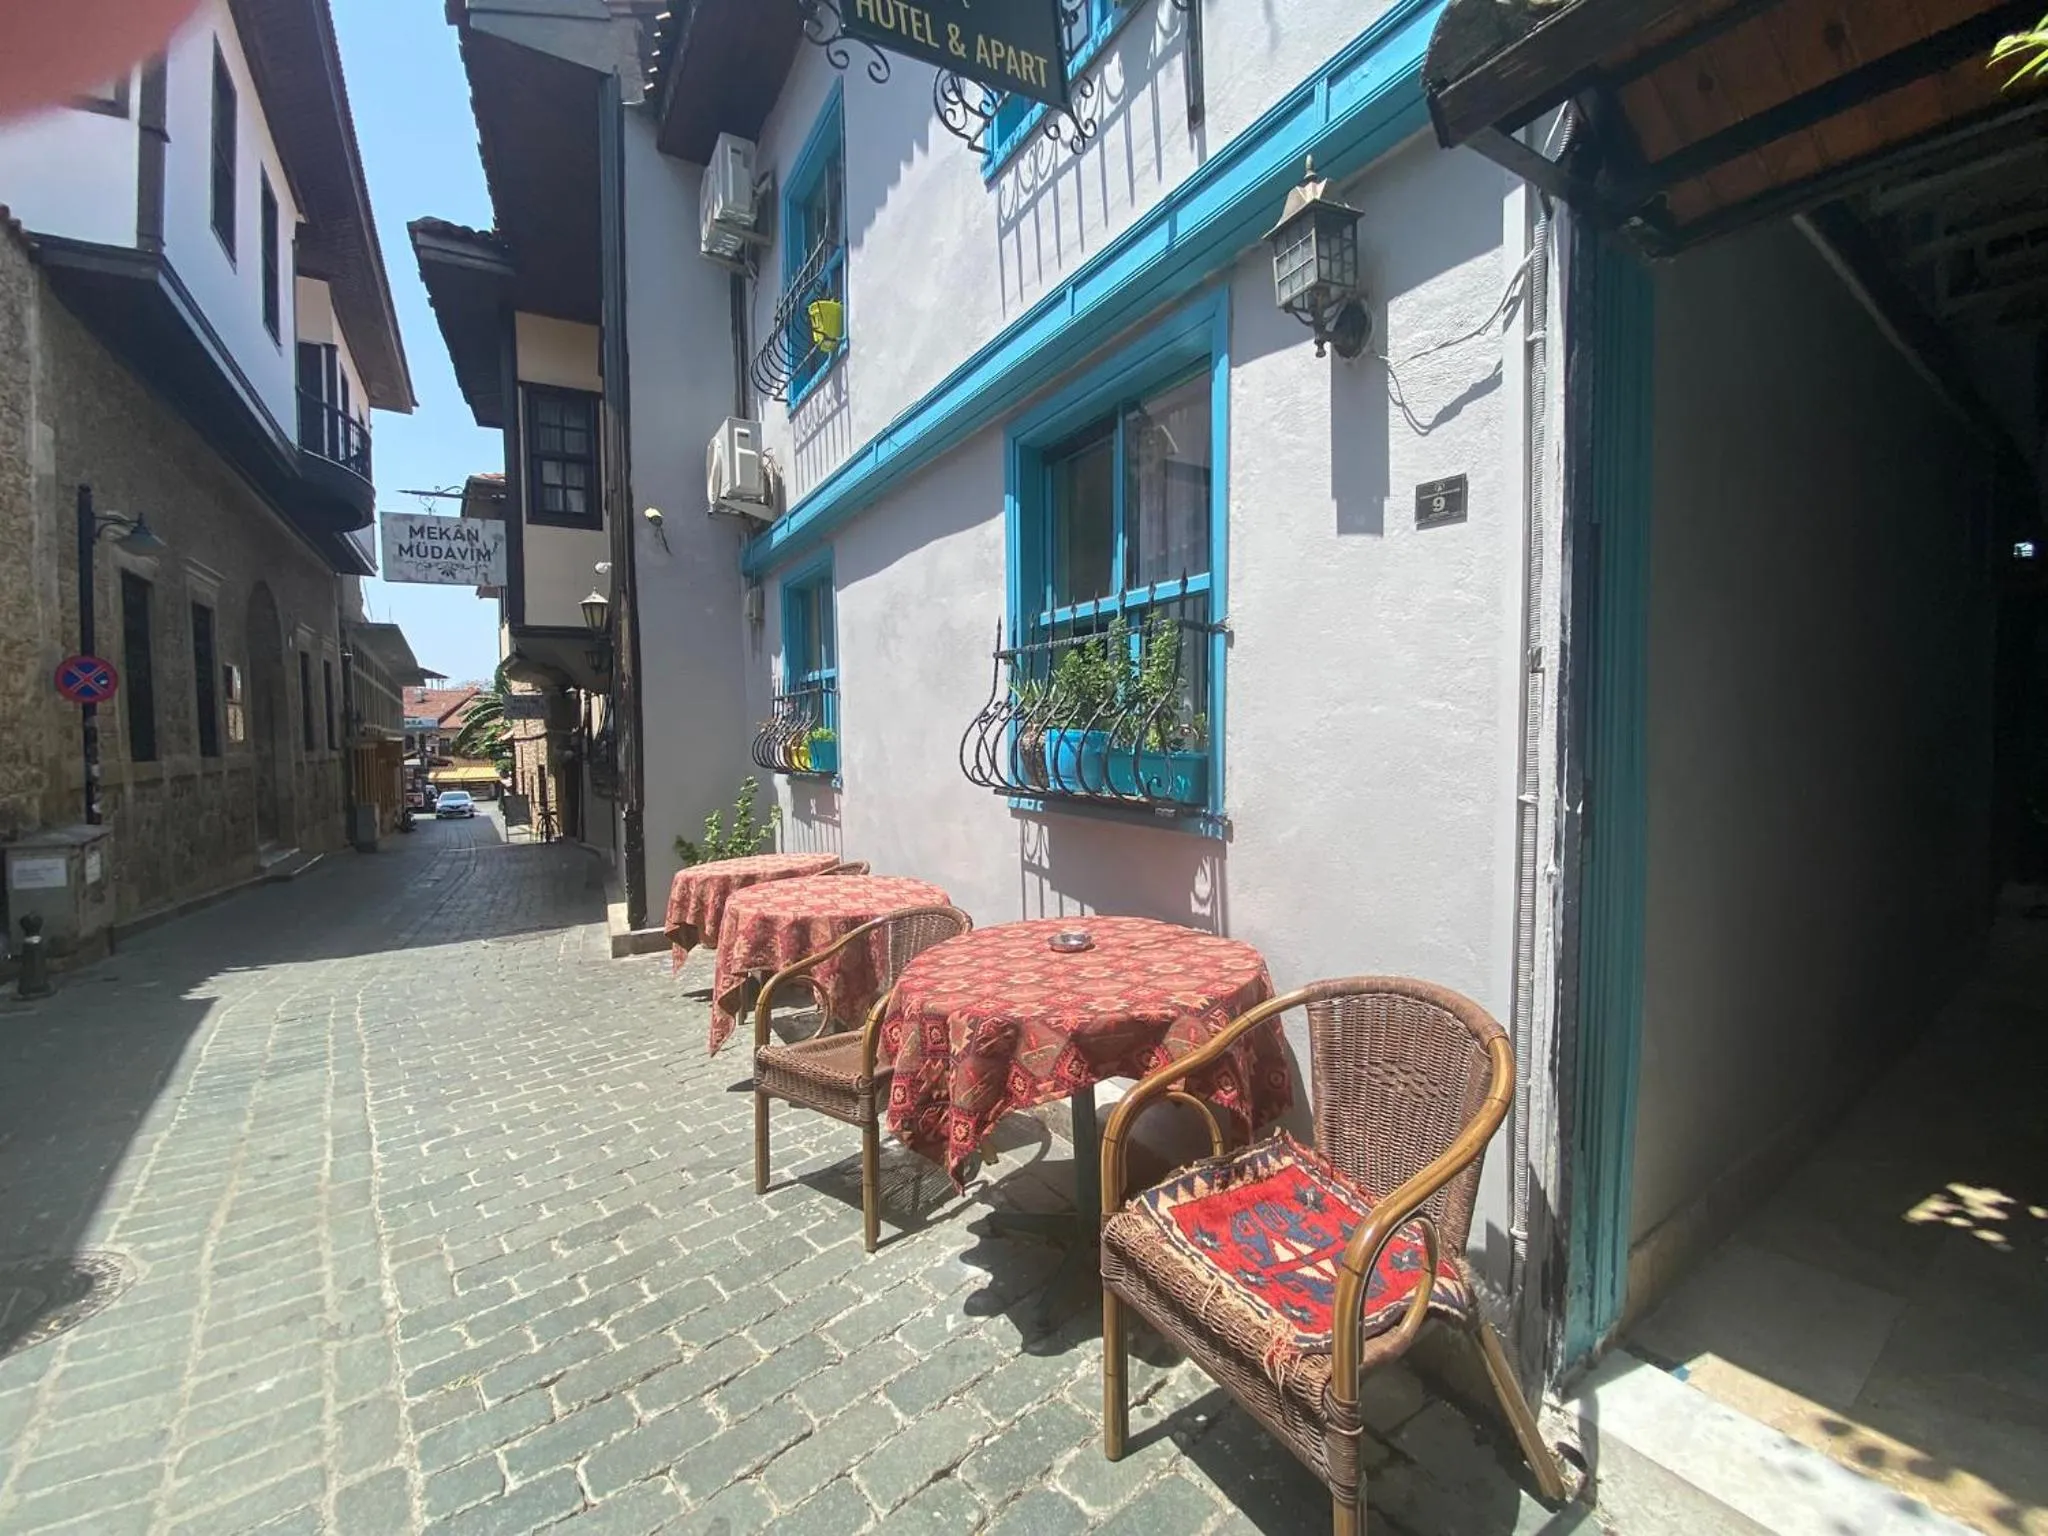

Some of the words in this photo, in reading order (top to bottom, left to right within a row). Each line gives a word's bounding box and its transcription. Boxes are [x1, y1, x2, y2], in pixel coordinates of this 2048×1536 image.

[856, 0, 940, 48] HOTEL
[947, 23, 967, 58] &
[976, 34, 1048, 88] APART
[1432, 497, 1445, 512] 9
